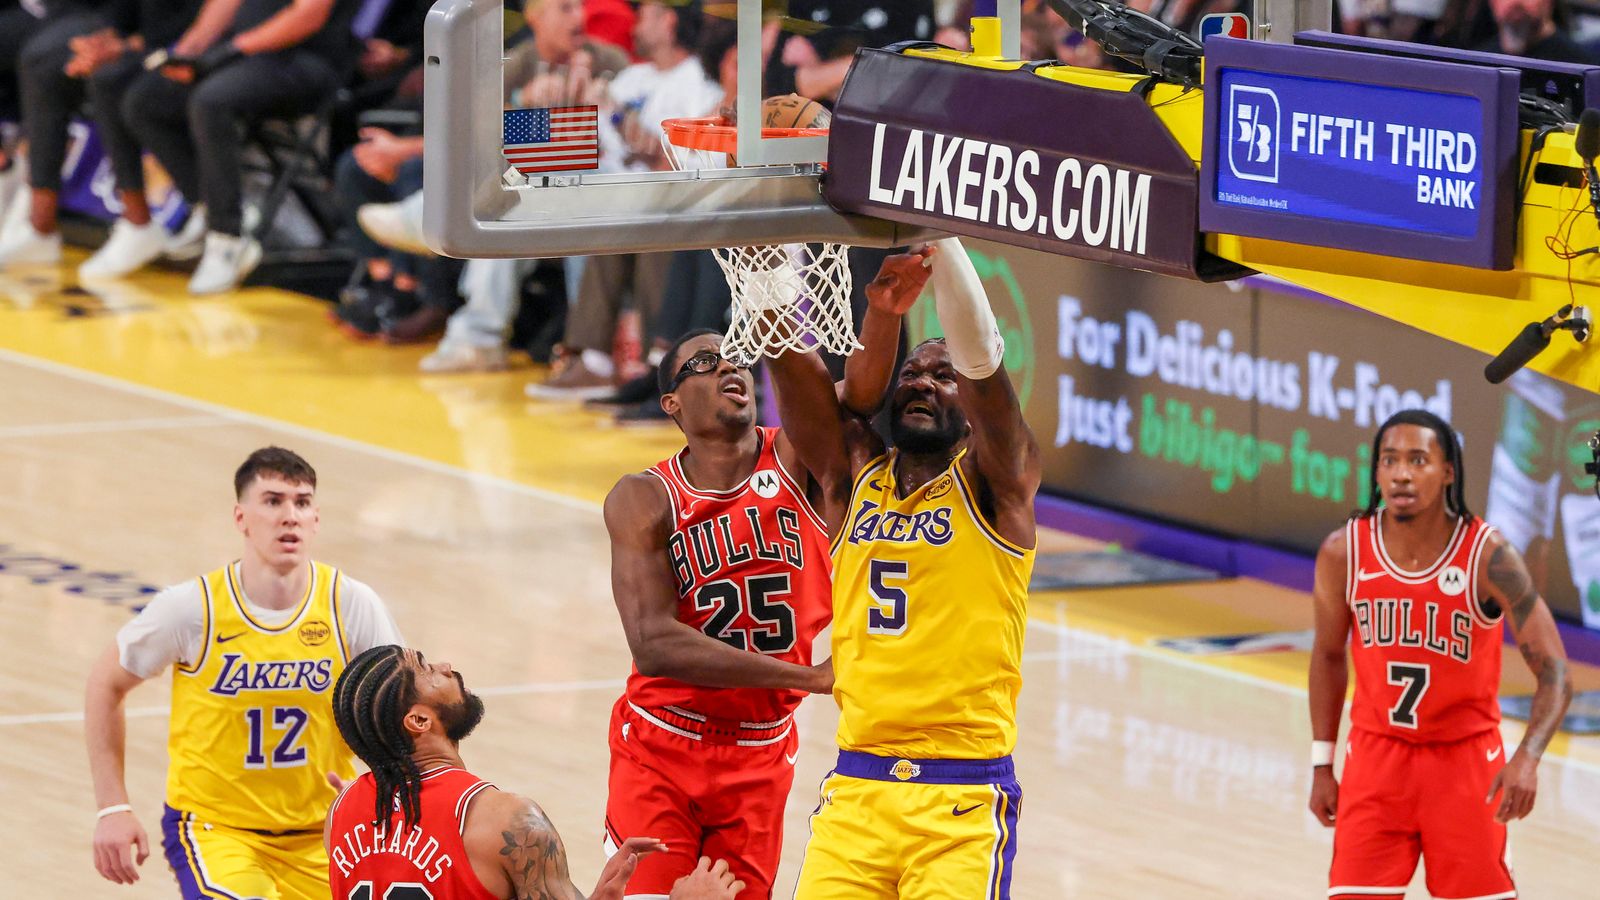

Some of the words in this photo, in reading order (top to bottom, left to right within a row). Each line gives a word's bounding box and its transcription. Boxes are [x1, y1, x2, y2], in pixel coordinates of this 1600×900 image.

[1291, 111, 1375, 163] FIFTH
[1386, 123, 1477, 174] THIRD
[868, 122, 1153, 256] LAKERS.COM
[1416, 174, 1476, 210] BANK
[1057, 295, 1120, 369] For
[1126, 309, 1302, 411] Delicious
[1055, 374, 1134, 453] Just
[1290, 428, 1351, 502] for
[668, 505, 805, 600] BULLS
[848, 499, 955, 547] LAKERS
[693, 571, 798, 655] 25
[866, 558, 910, 637] 5
[1354, 598, 1473, 664] BULLS
[209, 653, 333, 696] LAKERS
[1386, 661, 1431, 730] 7
[243, 705, 310, 770] 12
[331, 818, 453, 884] RICHARDS
